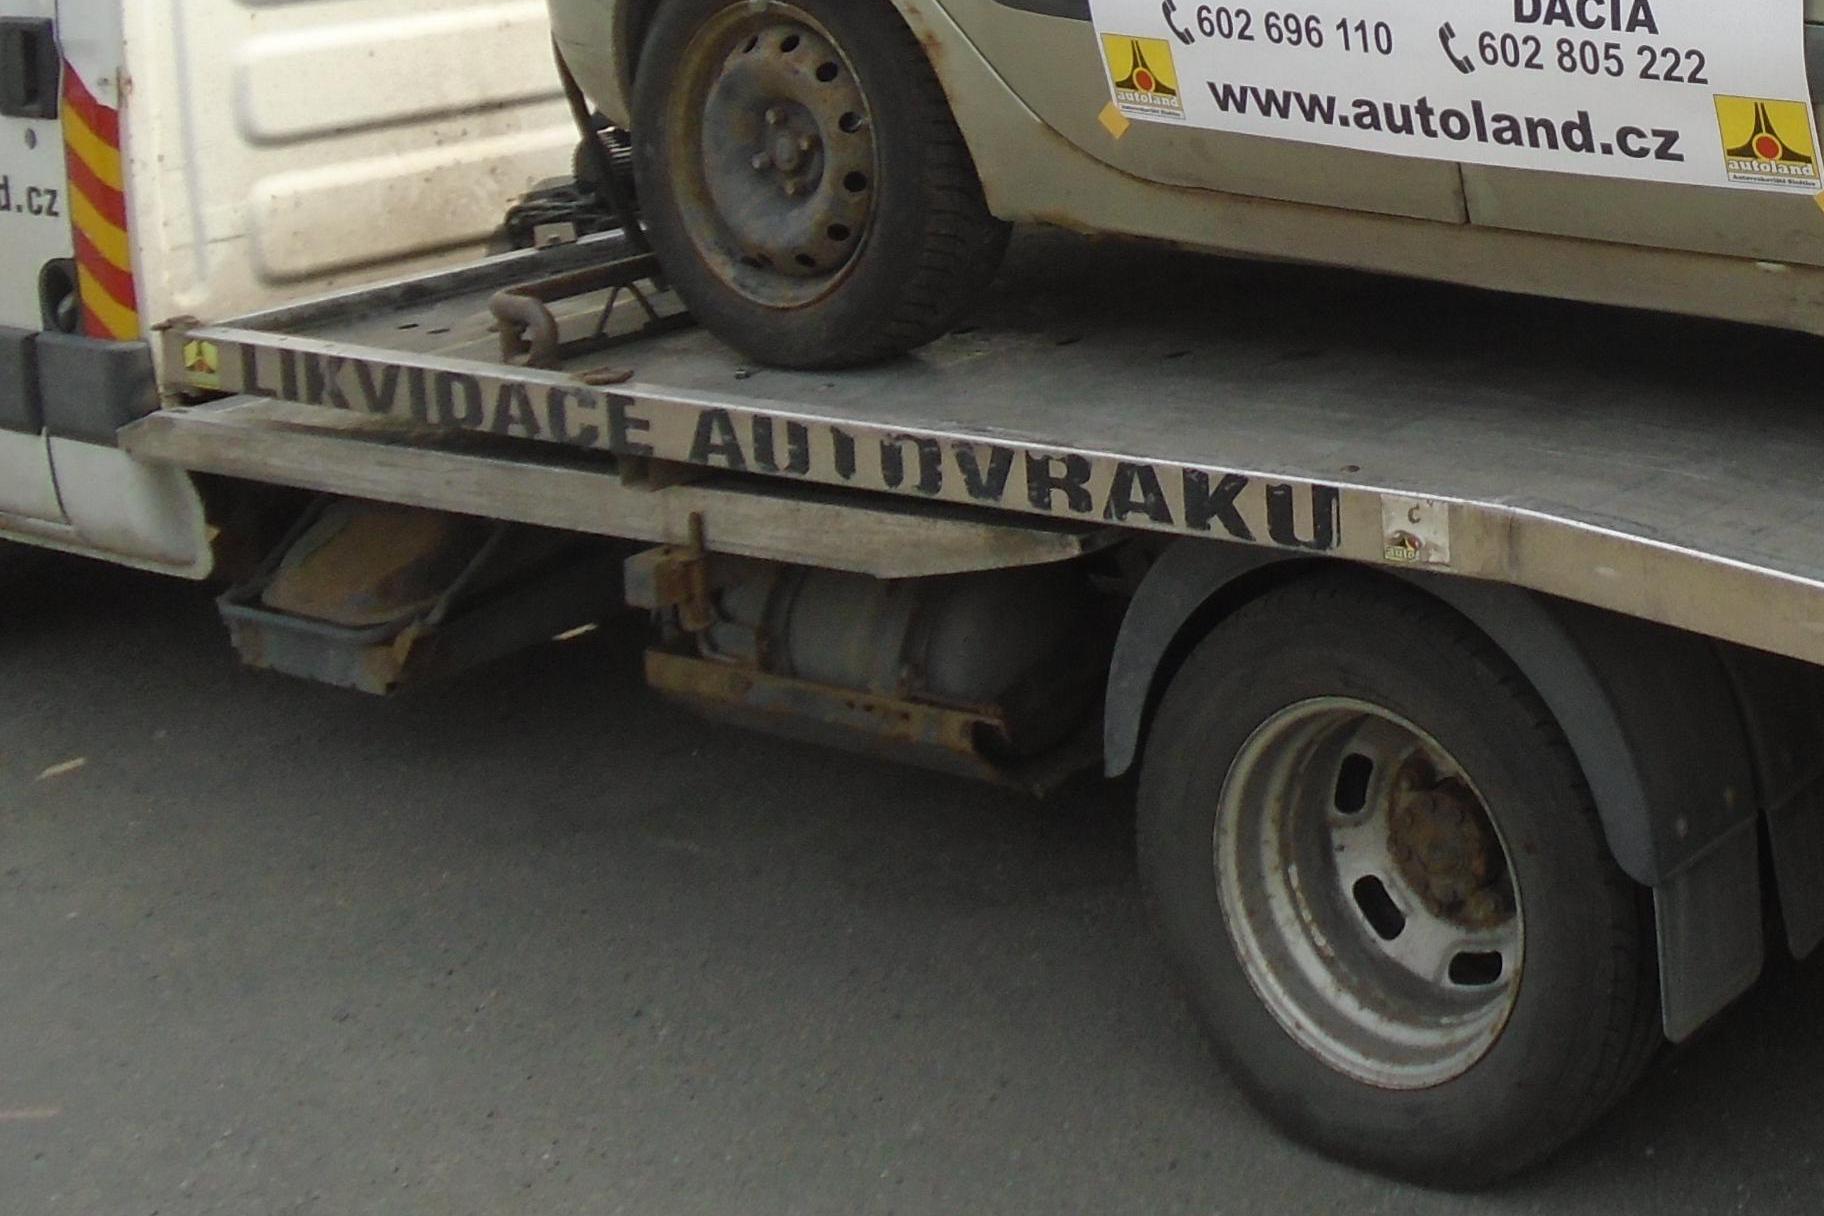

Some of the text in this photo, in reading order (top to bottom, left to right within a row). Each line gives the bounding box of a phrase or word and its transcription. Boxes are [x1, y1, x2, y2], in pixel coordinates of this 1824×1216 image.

[1196, 4, 1393, 55] 602 696 110
[1478, 31, 1708, 85] 602 805 222
[1206, 82, 1686, 162] www.autoland.cz
[1728, 160, 1815, 176] autoland
[240, 342, 654, 456] LIKVIDACE
